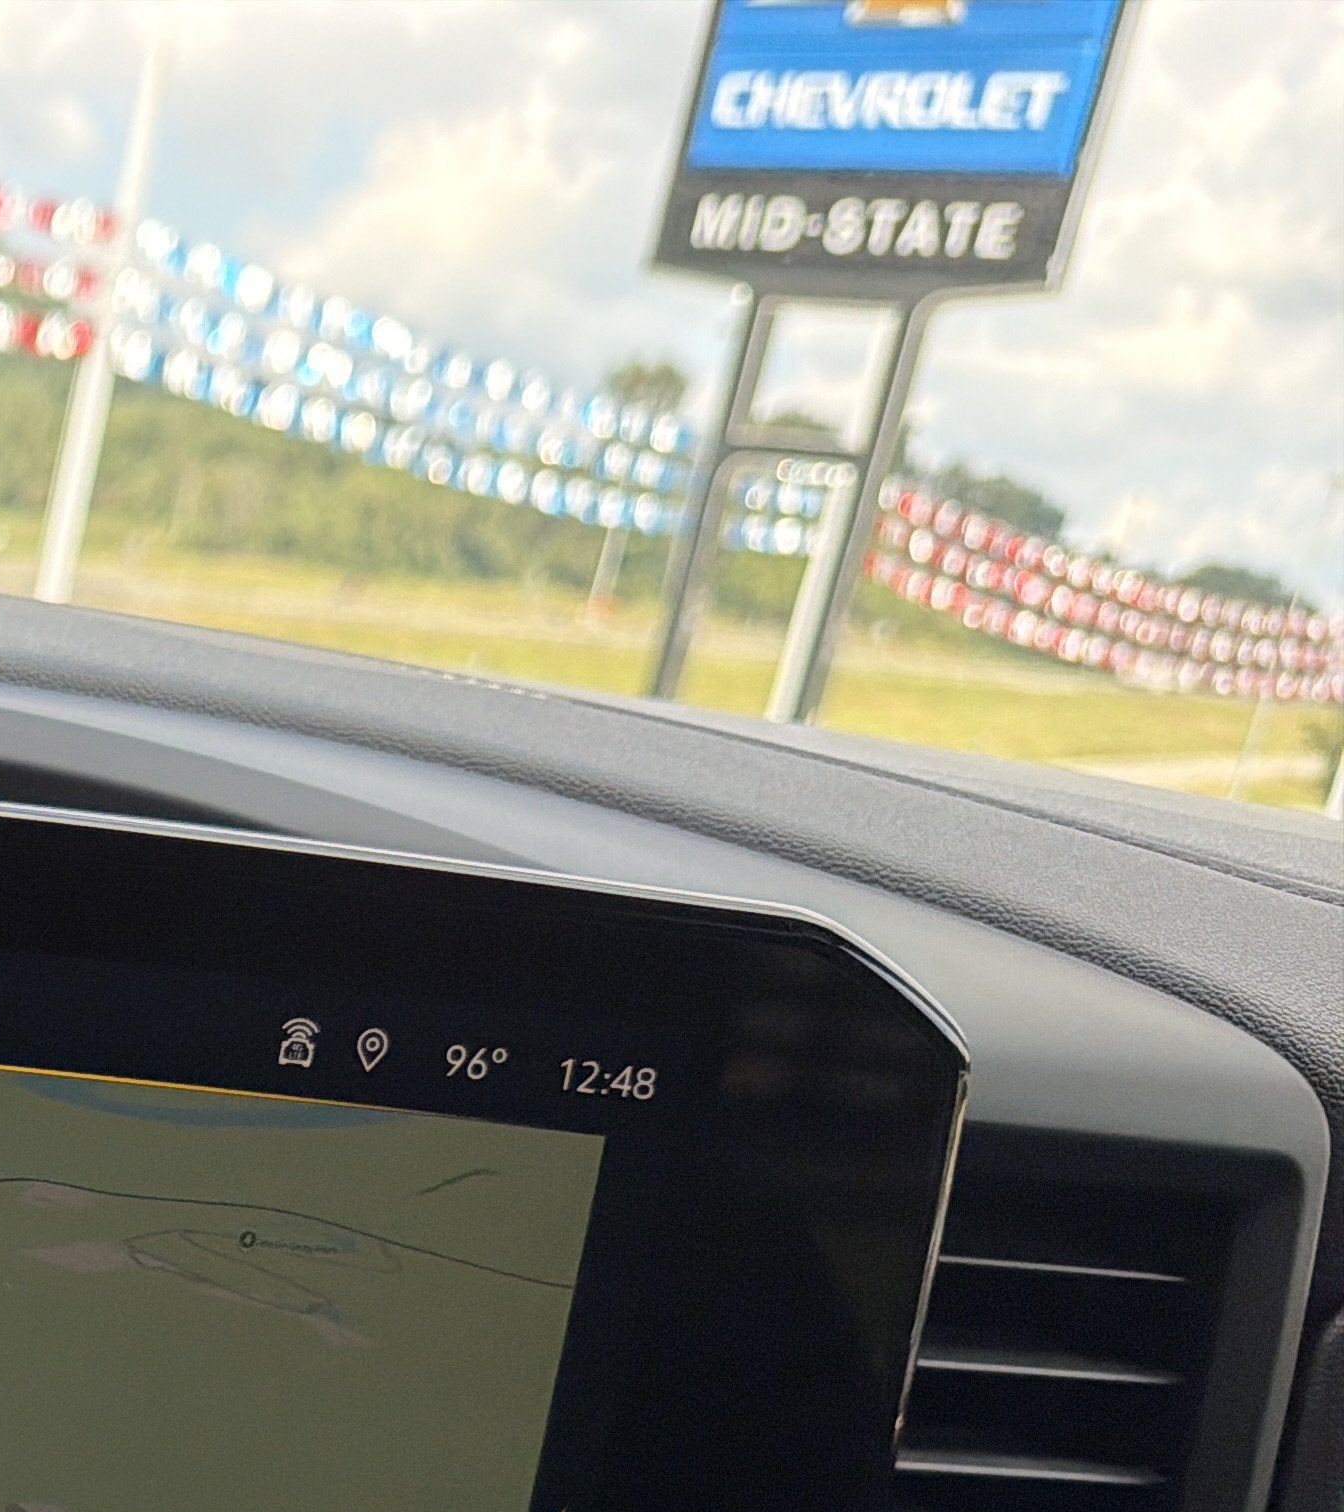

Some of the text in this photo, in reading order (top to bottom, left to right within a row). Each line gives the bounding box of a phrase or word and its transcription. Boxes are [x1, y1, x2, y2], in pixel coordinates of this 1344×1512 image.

[711, 68, 1069, 131] CHEVROLET
[690, 193, 1025, 260] MID-STATE
[559, 1057, 658, 1101] 12:48
